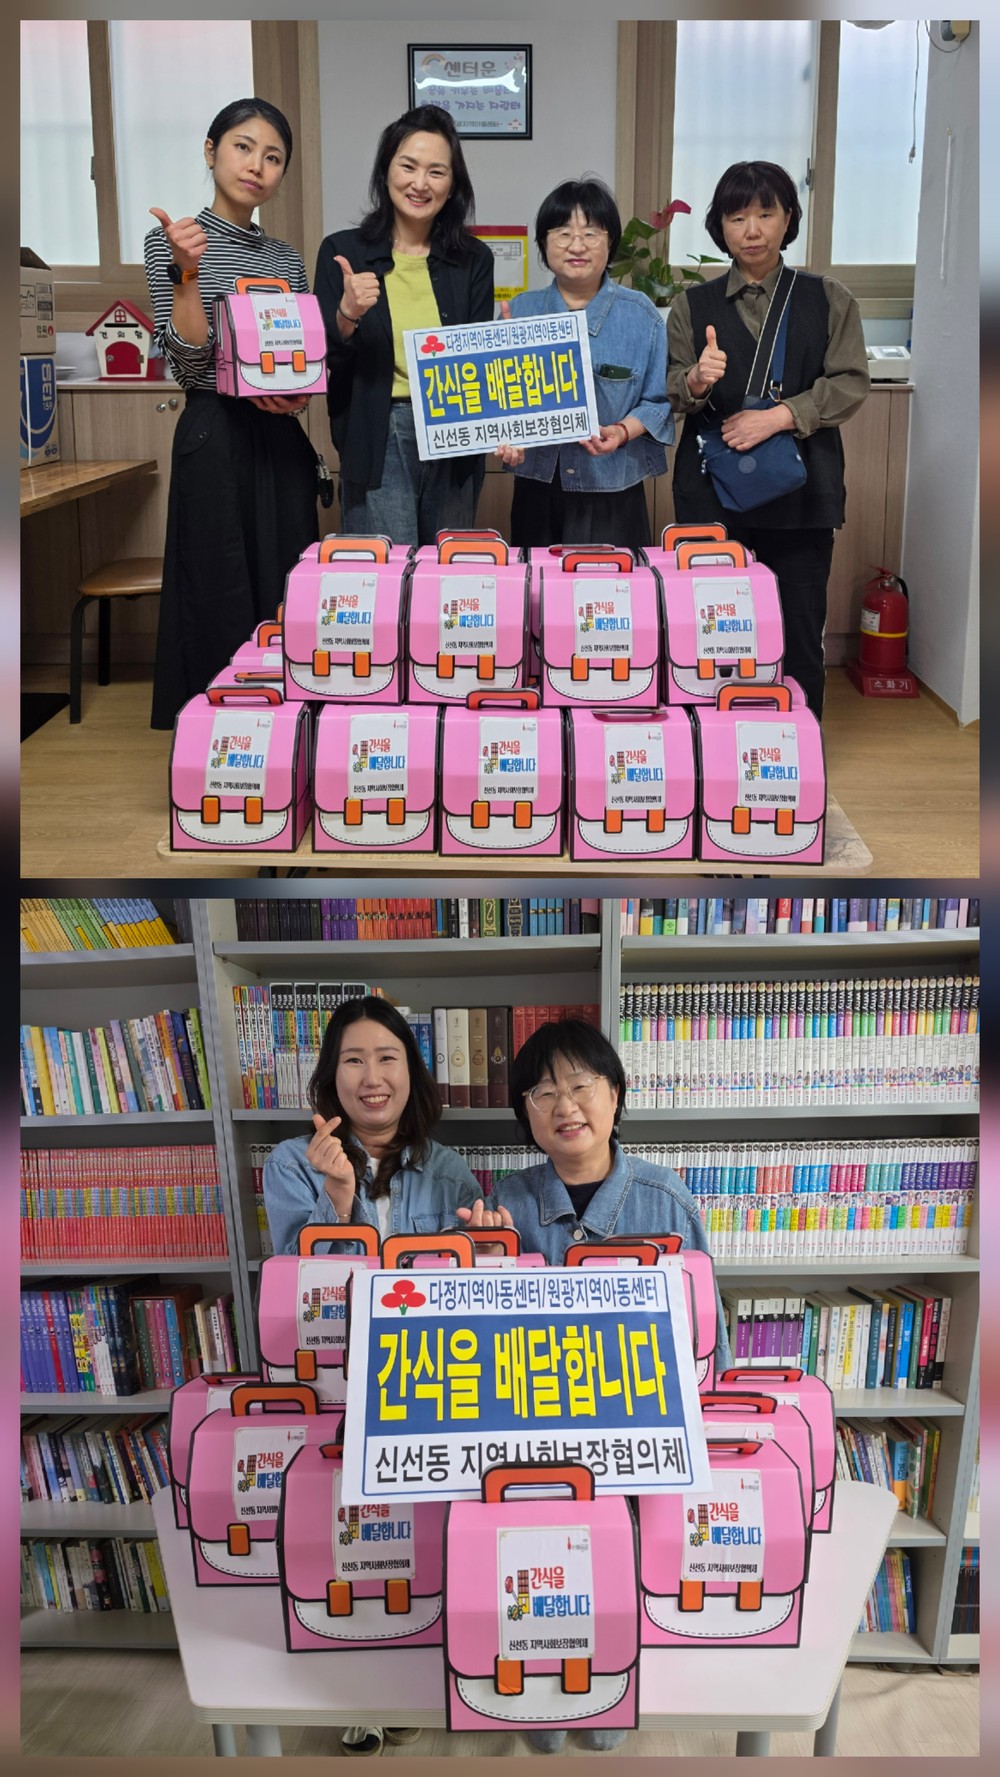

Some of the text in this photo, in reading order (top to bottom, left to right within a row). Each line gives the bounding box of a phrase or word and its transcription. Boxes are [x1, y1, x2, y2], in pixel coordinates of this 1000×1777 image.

[444, 61, 496, 77] 센터훈
[446, 320, 573, 352] 다정지역아동센터/원광지역아동센터
[424, 349, 578, 417] 간식을 배달합니다
[433, 412, 588, 449] 신선동 지역사회보장협의체
[338, 596, 360, 608] 간식을
[460, 598, 480, 611] 간식을
[594, 602, 616, 614] 간식을
[336, 610, 372, 624] 배달합니다
[716, 604, 736, 617] 간식을
[458, 614, 495, 628] 배달합니다
[594, 616, 631, 630] 배달합니다
[716, 618, 753, 632] 배달합니다
[228, 734, 250, 750] 간식을
[370, 738, 392, 752] 간식을
[498, 740, 522, 754] 간식을
[226, 752, 265, 768] 배달합니다
[368, 754, 405, 770] 배달합니다
[626, 750, 648, 764] 간식을
[758, 748, 782, 762] 간식을
[498, 758, 536, 772] 배달합니다
[760, 764, 799, 780] 배달합니다
[626, 766, 663, 782] 배달합니다
[429, 1277, 661, 1310] 다정지역아동센터/원광지역아동센터
[377, 1328, 482, 1421] 간식을
[494, 1323, 667, 1418] 배달합니다
[257, 1452, 283, 1468] 간식을
[375, 1444, 451, 1484] 신선동
[360, 1504, 390, 1518] 간식을
[709, 1502, 739, 1522] 간식을
[360, 1522, 413, 1542] 배달합니다
[710, 1526, 762, 1546] 배달합니다
[530, 1566, 565, 1590] 간식을
[531, 1594, 592, 1616] 배달합니다
[508, 1637, 528, 1651] 신선동
